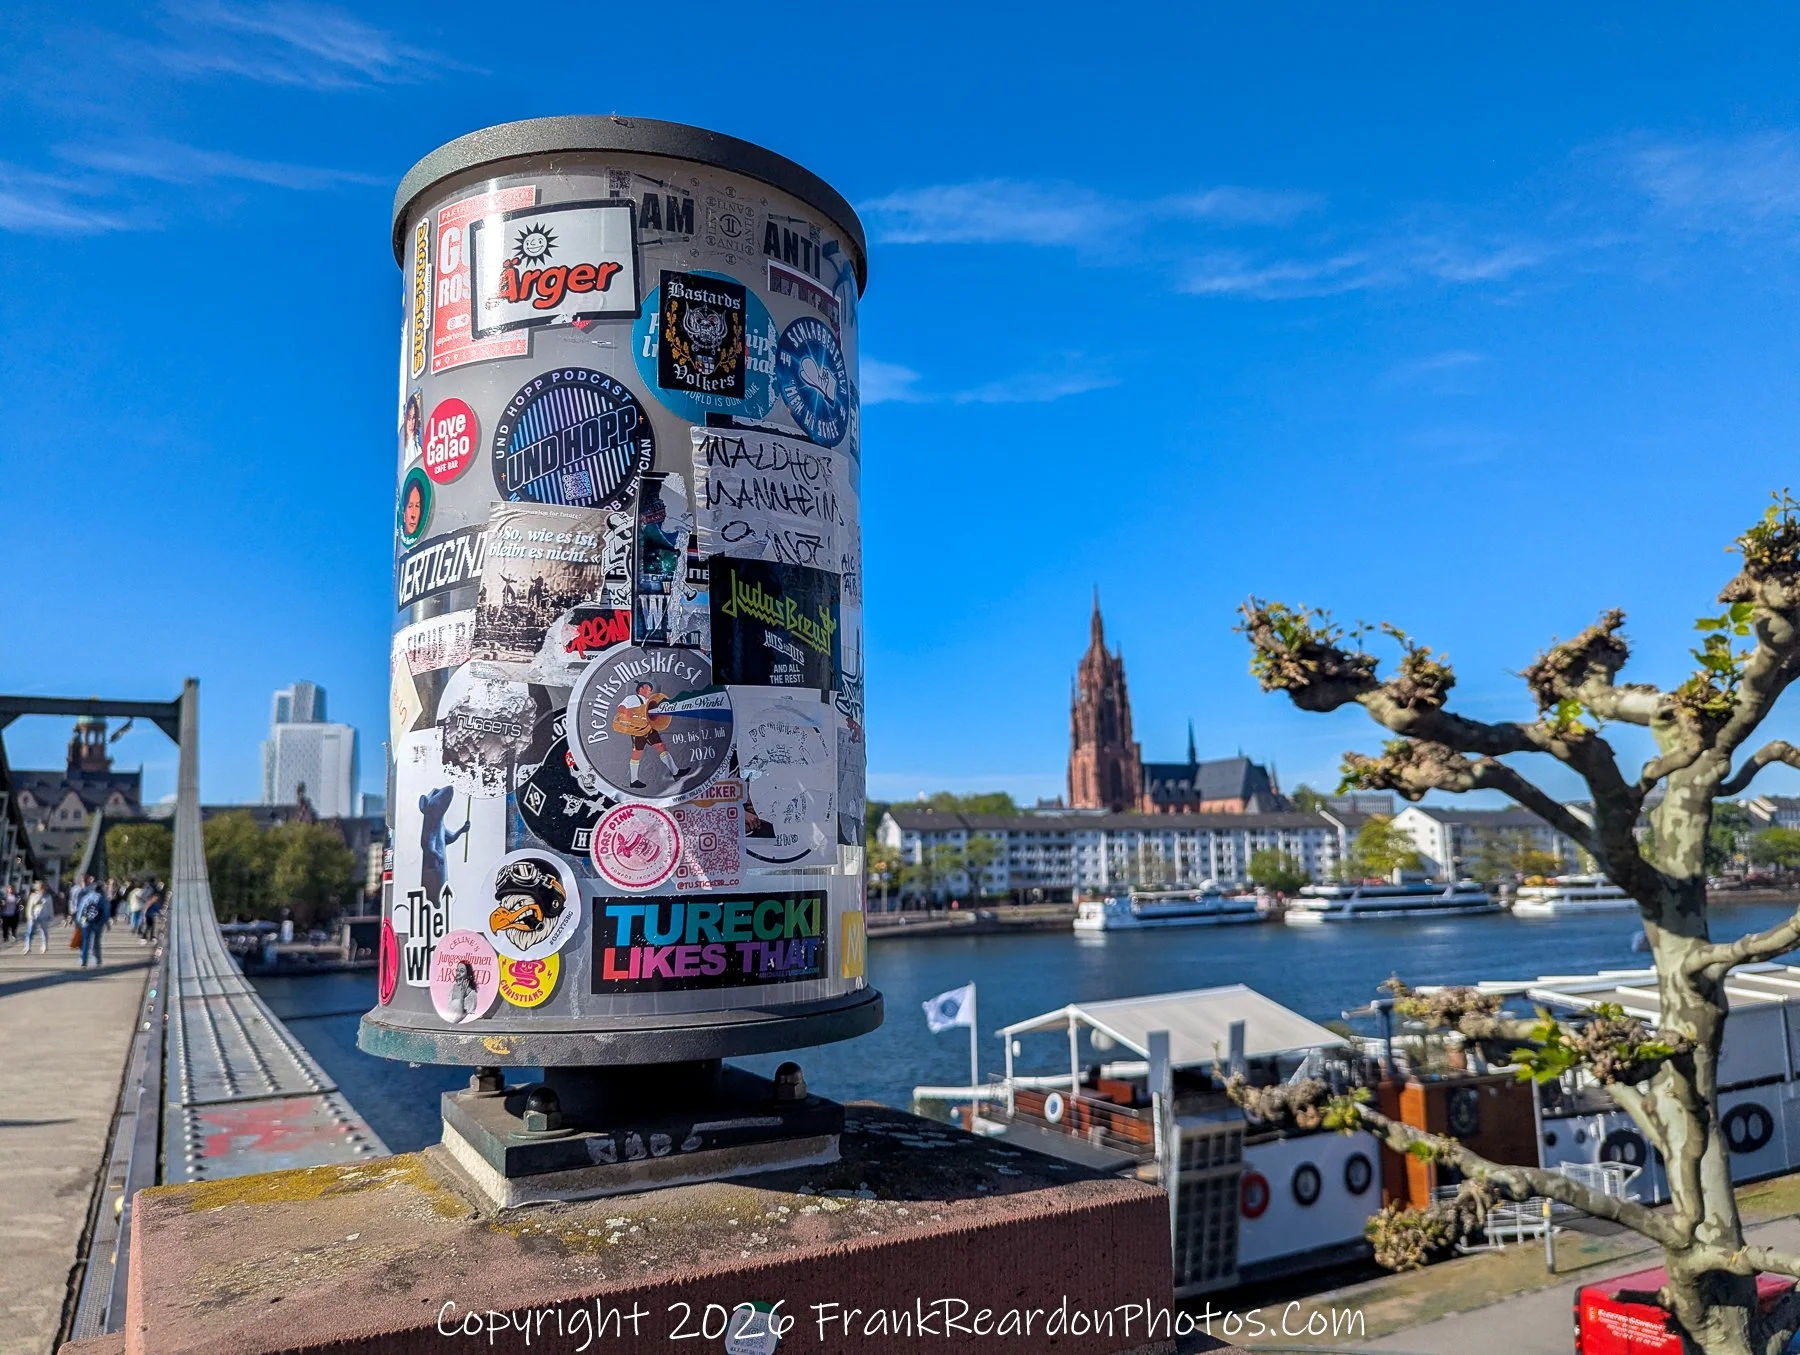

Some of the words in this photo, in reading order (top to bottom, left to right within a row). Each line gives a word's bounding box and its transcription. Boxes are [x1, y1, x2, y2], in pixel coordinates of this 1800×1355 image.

[639, 192, 694, 234] AM
[763, 220, 820, 279] ANTI
[499, 257, 623, 309] Ärger
[667, 281, 741, 310] Bastards
[673, 363, 735, 391] Volkers
[496, 424, 509, 460] UND
[507, 379, 543, 417] HOPP
[552, 370, 632, 403] PODCAST
[714, 398, 723, 407] IS
[430, 413, 466, 441] Love
[427, 431, 471, 466] Galão
[507, 435, 559, 492] UND
[563, 405, 637, 466] HOPP
[447, 460, 459, 471] BAR
[488, 541, 526, 559] bleibt
[528, 548, 544, 560] es
[528, 528, 554, 542] wie
[556, 533, 572, 544] es
[574, 533, 598, 549] ist,
[764, 630, 784, 648] HITS
[788, 643, 805, 666] TITS
[769, 675, 784, 684] THE
[785, 674, 804, 683] REST!
[773, 664, 787, 673] AND
[788, 664, 800, 673] ALL
[588, 651, 702, 745] BezirksMusikfest
[657, 701, 678, 713] Reit
[681, 702, 693, 710] im
[694, 697, 724, 709] Winkl
[672, 734, 687, 744] 09.
[688, 731, 700, 741] bis
[701, 729, 712, 740] 12.
[714, 727, 726, 738] Juli
[689, 746, 716, 762] 2026
[600, 831, 612, 855] DAS
[608, 809, 635, 831] PINK
[408, 891, 443, 938] The
[605, 898, 821, 947] TURECKI
[450, 936, 480, 953] CELINE'S
[603, 943, 726, 980] LIKES
[736, 938, 820, 974] THAT
